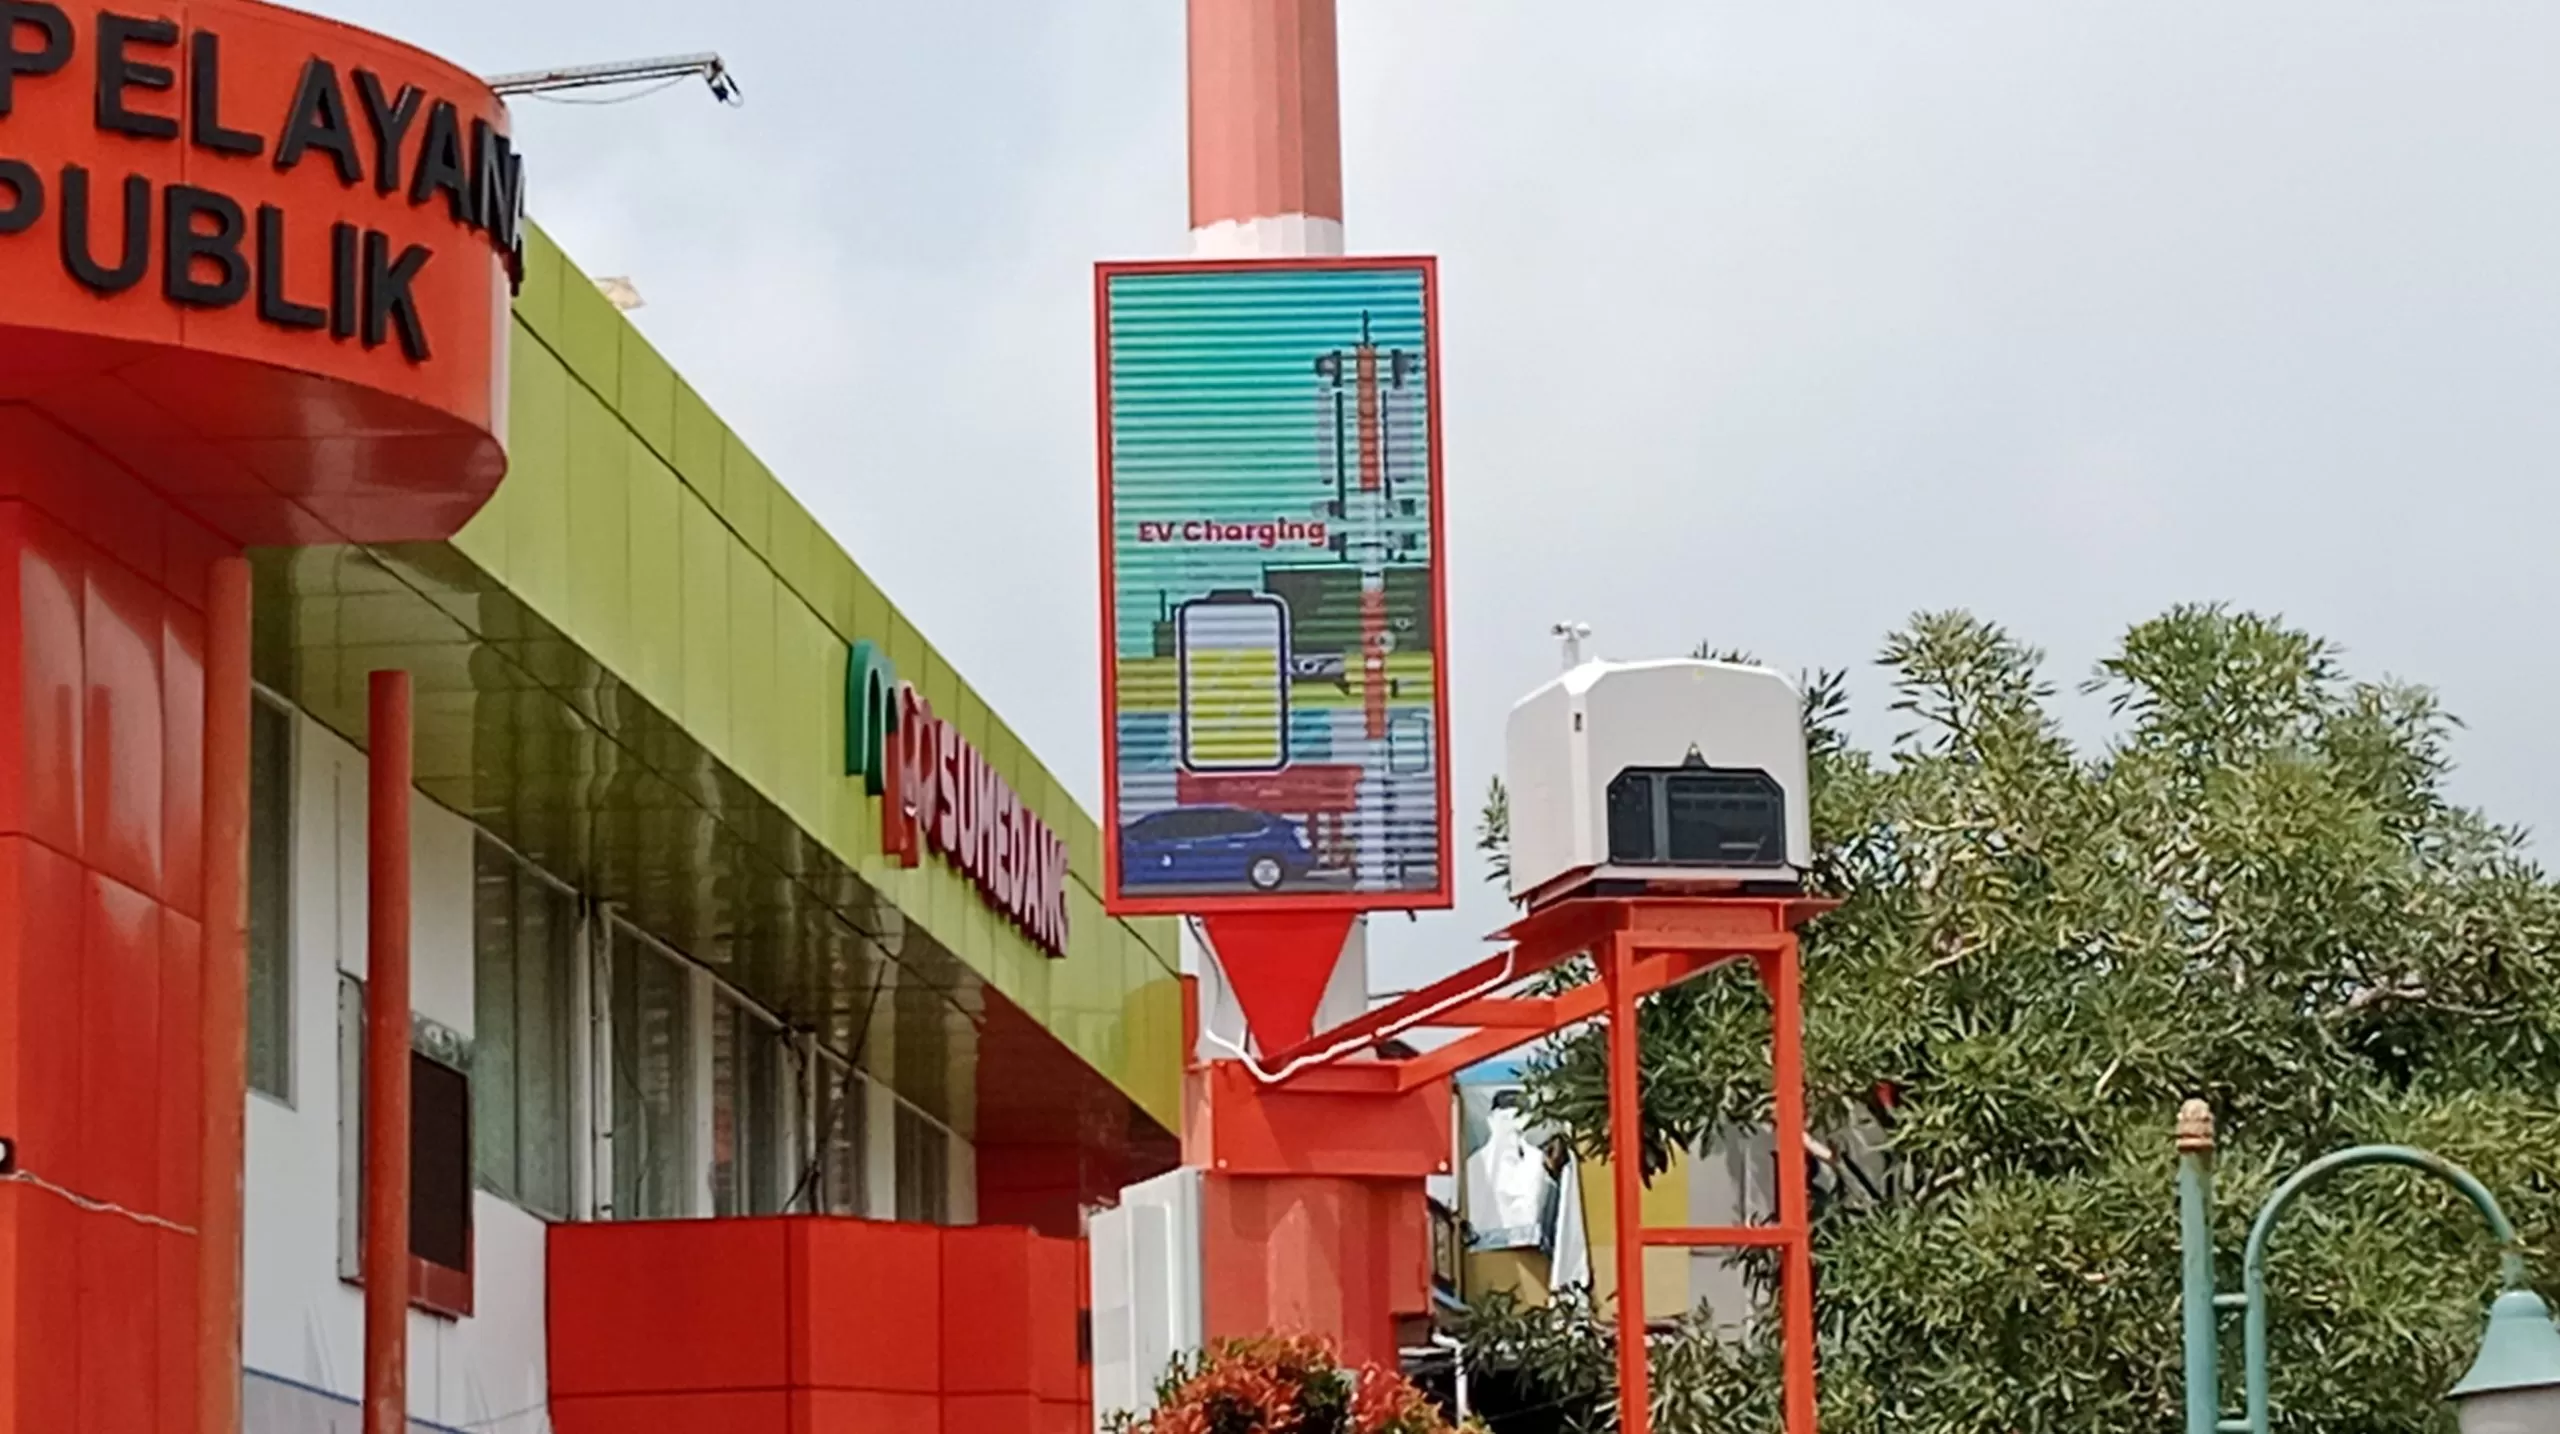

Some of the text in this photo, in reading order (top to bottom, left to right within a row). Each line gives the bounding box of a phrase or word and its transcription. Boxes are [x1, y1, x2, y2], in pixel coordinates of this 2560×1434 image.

[0, 158, 432, 361] PUBLIK
[1138, 516, 1325, 548] EV Charging
[937, 717, 1069, 957] SUMEDANG
